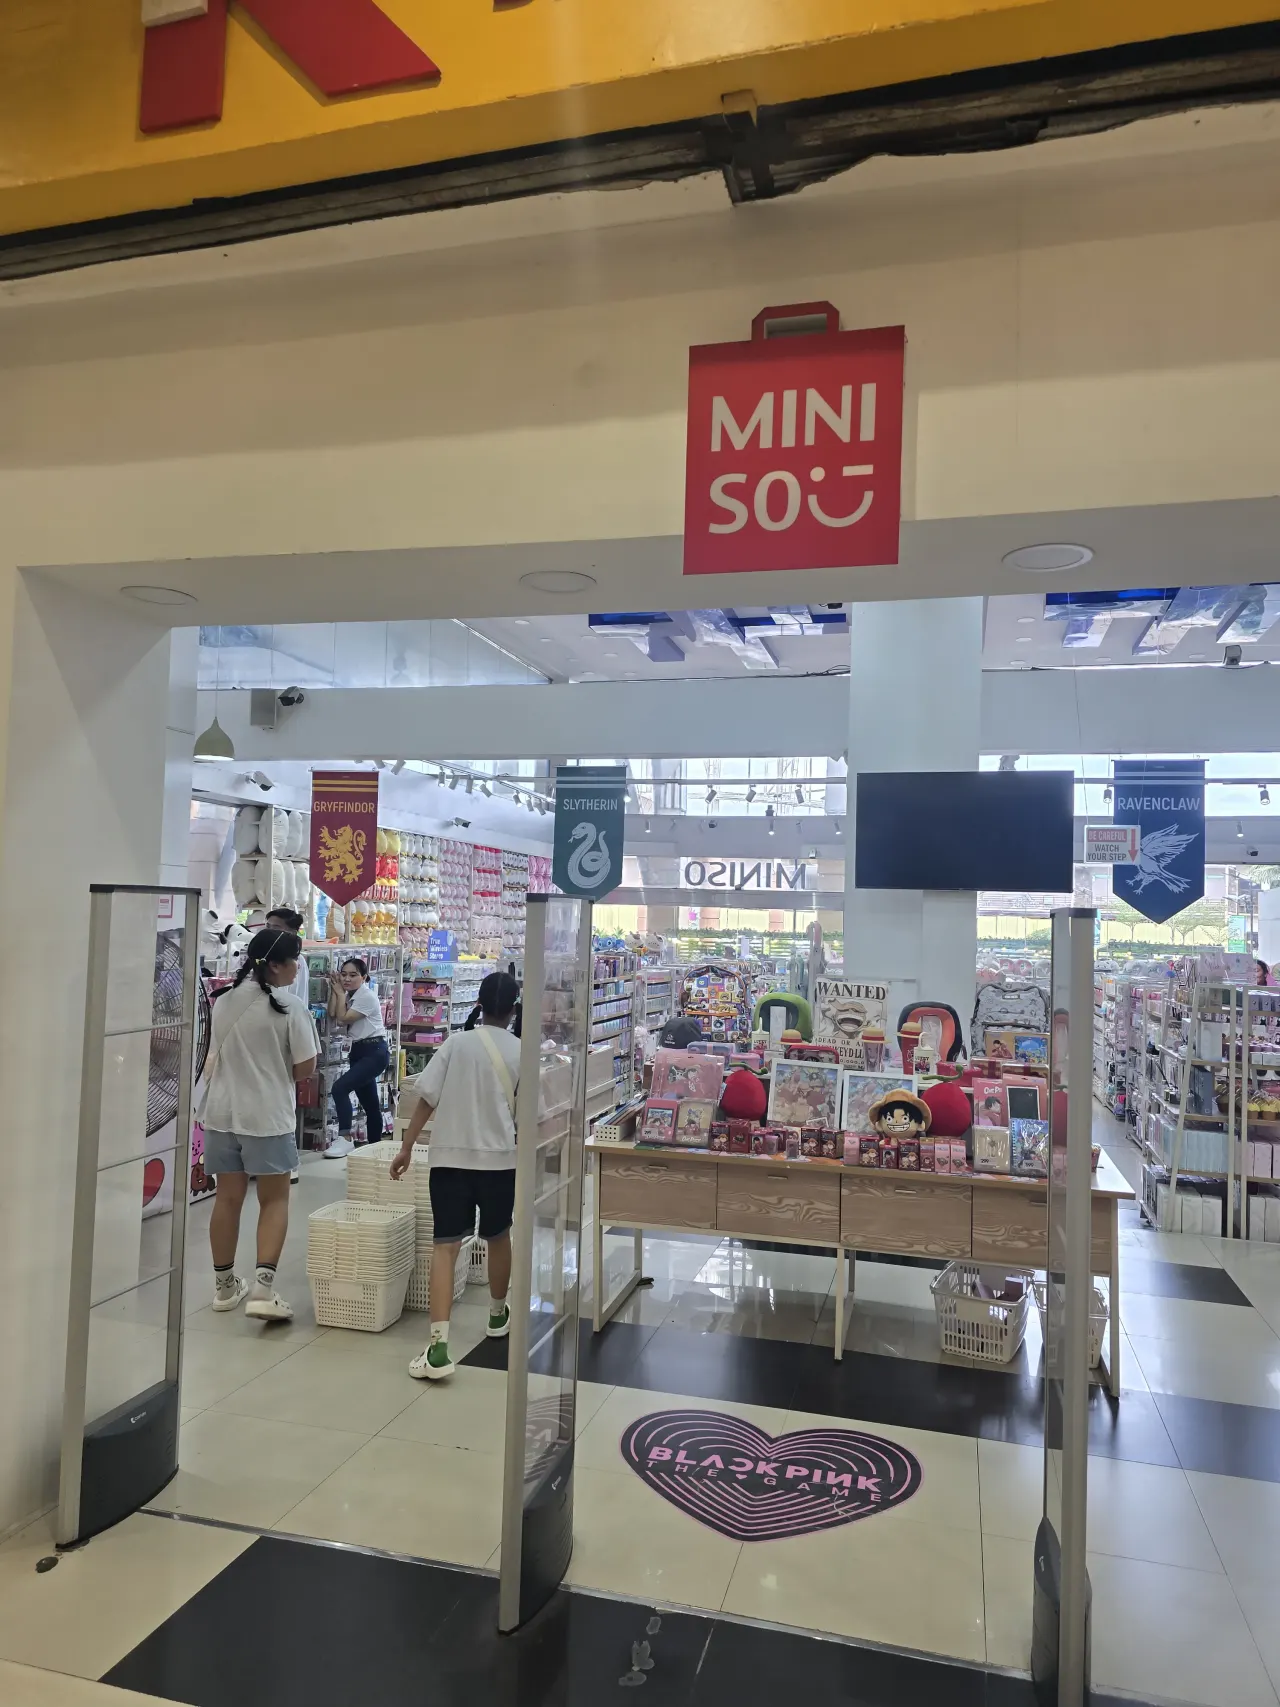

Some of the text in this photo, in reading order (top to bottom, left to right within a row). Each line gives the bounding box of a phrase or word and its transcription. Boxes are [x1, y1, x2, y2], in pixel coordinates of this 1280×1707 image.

[710, 382, 877, 452] MINI
[313, 800, 375, 814] GRYFFINDOR
[563, 798, 618, 811] SLYTHERIN
[1117, 797, 1200, 811] RAVENCLAW
[1098, 830, 1127, 841] CAREFUL
[1094, 844, 1120, 852] WATCH
[1087, 852, 1127, 861] YOUR STEP
[817, 981, 886, 1001] WANTED
[818, 1037, 837, 1045] DEAD
[646, 1460, 882, 1503] THE GAME
